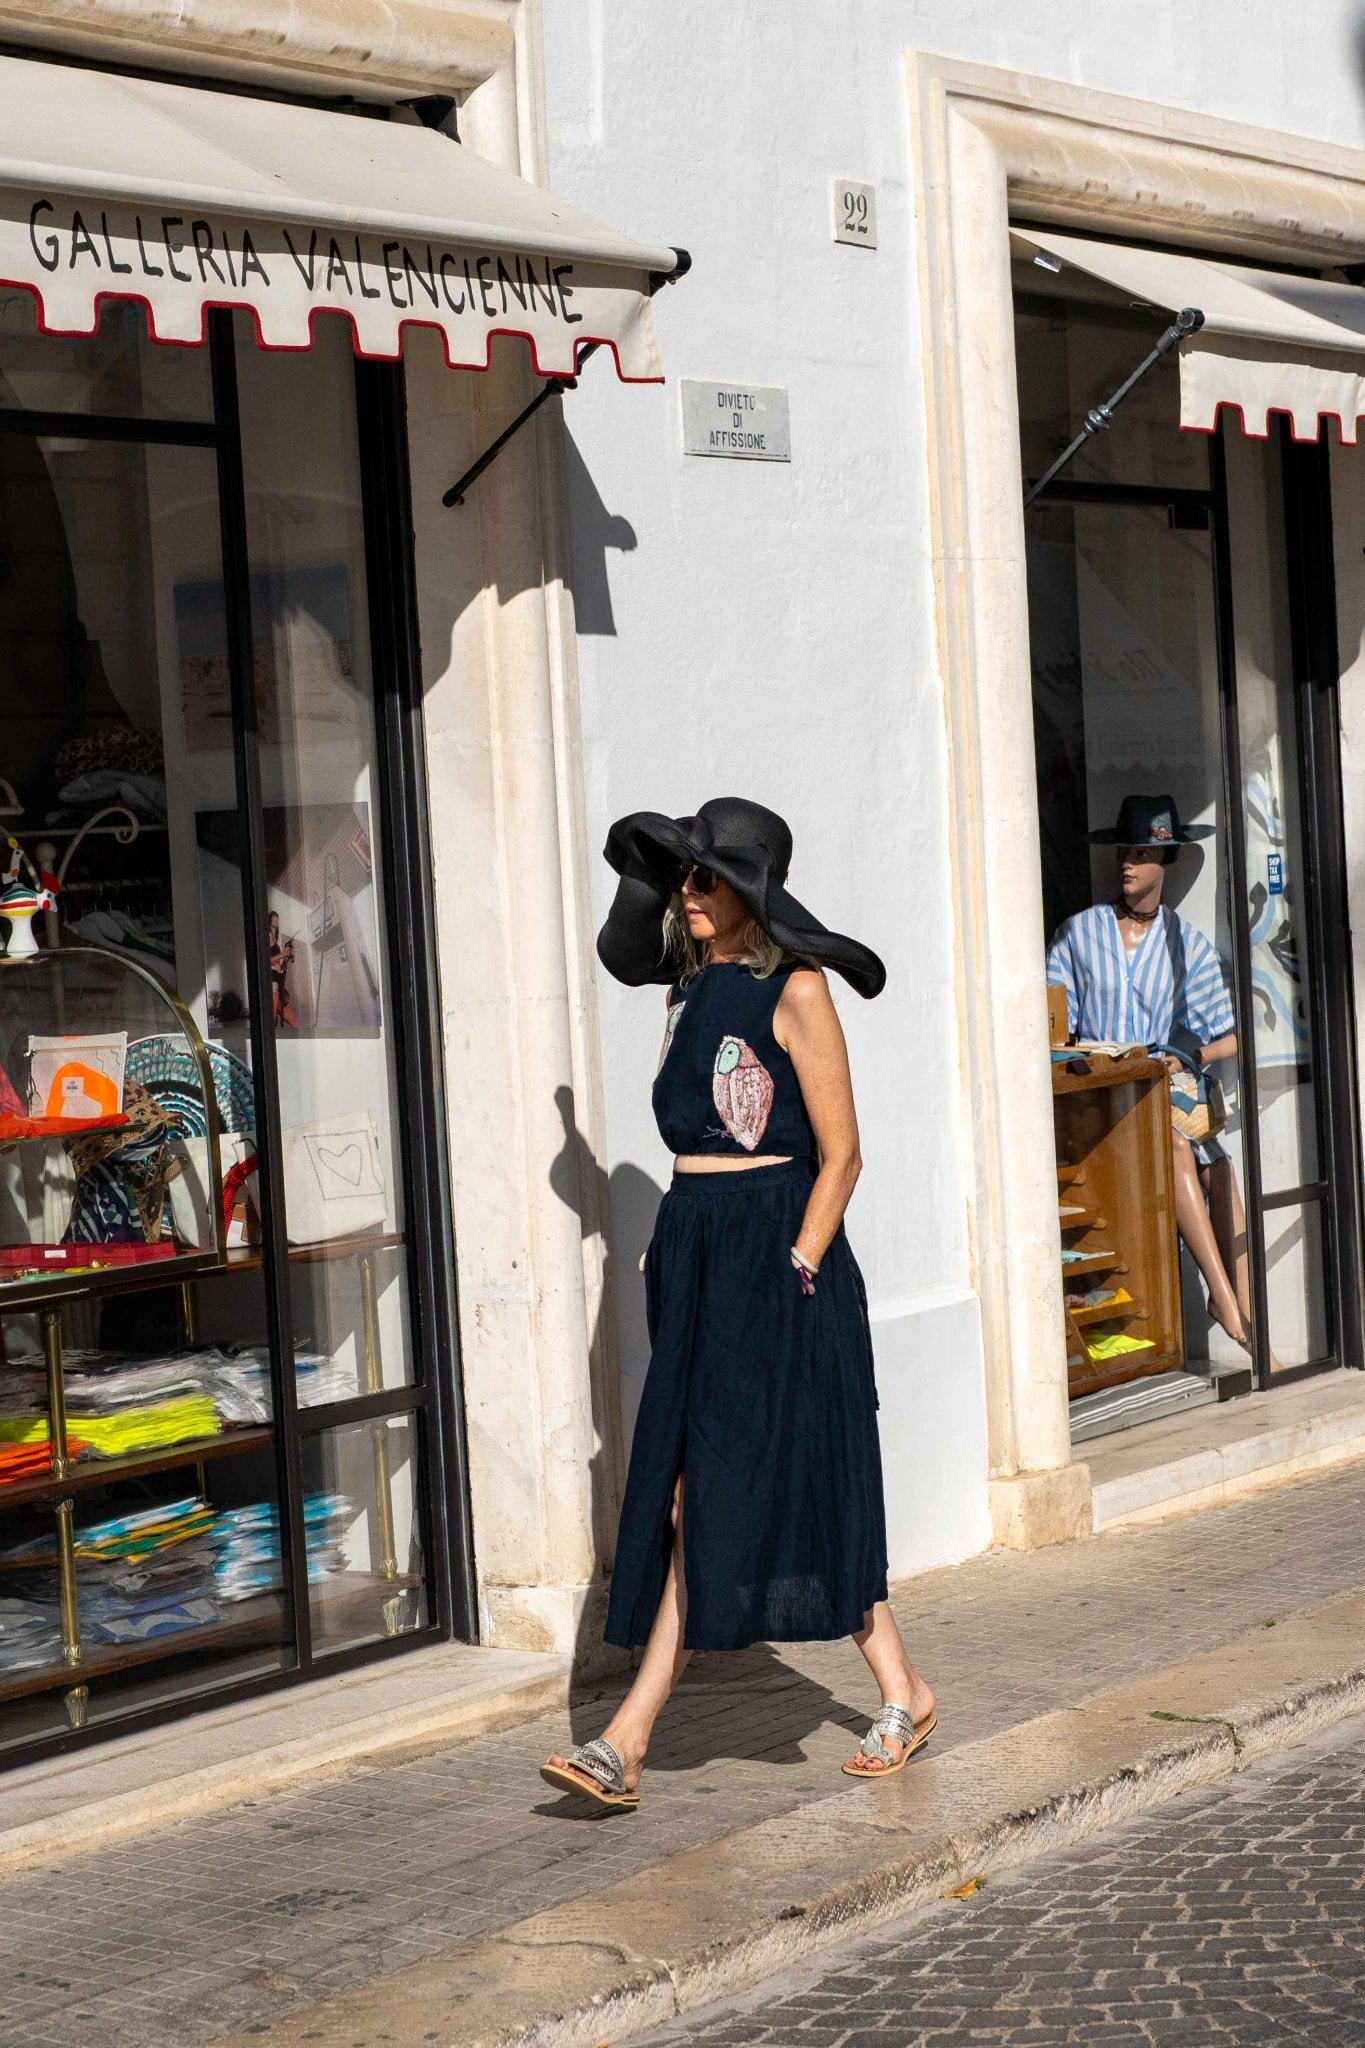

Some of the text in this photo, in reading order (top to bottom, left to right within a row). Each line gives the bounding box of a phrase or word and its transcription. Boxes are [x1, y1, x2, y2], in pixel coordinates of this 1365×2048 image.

[844, 192, 868, 234] 22
[30, 199, 583, 323] GALLERIA VALENCIENNE
[717, 392, 756, 410] DIVIETO
[732, 412, 743, 428] DI
[709, 430, 767, 450] AFFISSIONE
[1268, 857, 1280, 866] SHOP
[1269, 866, 1278, 875] TAX
[1269, 874, 1281, 884] FREE
